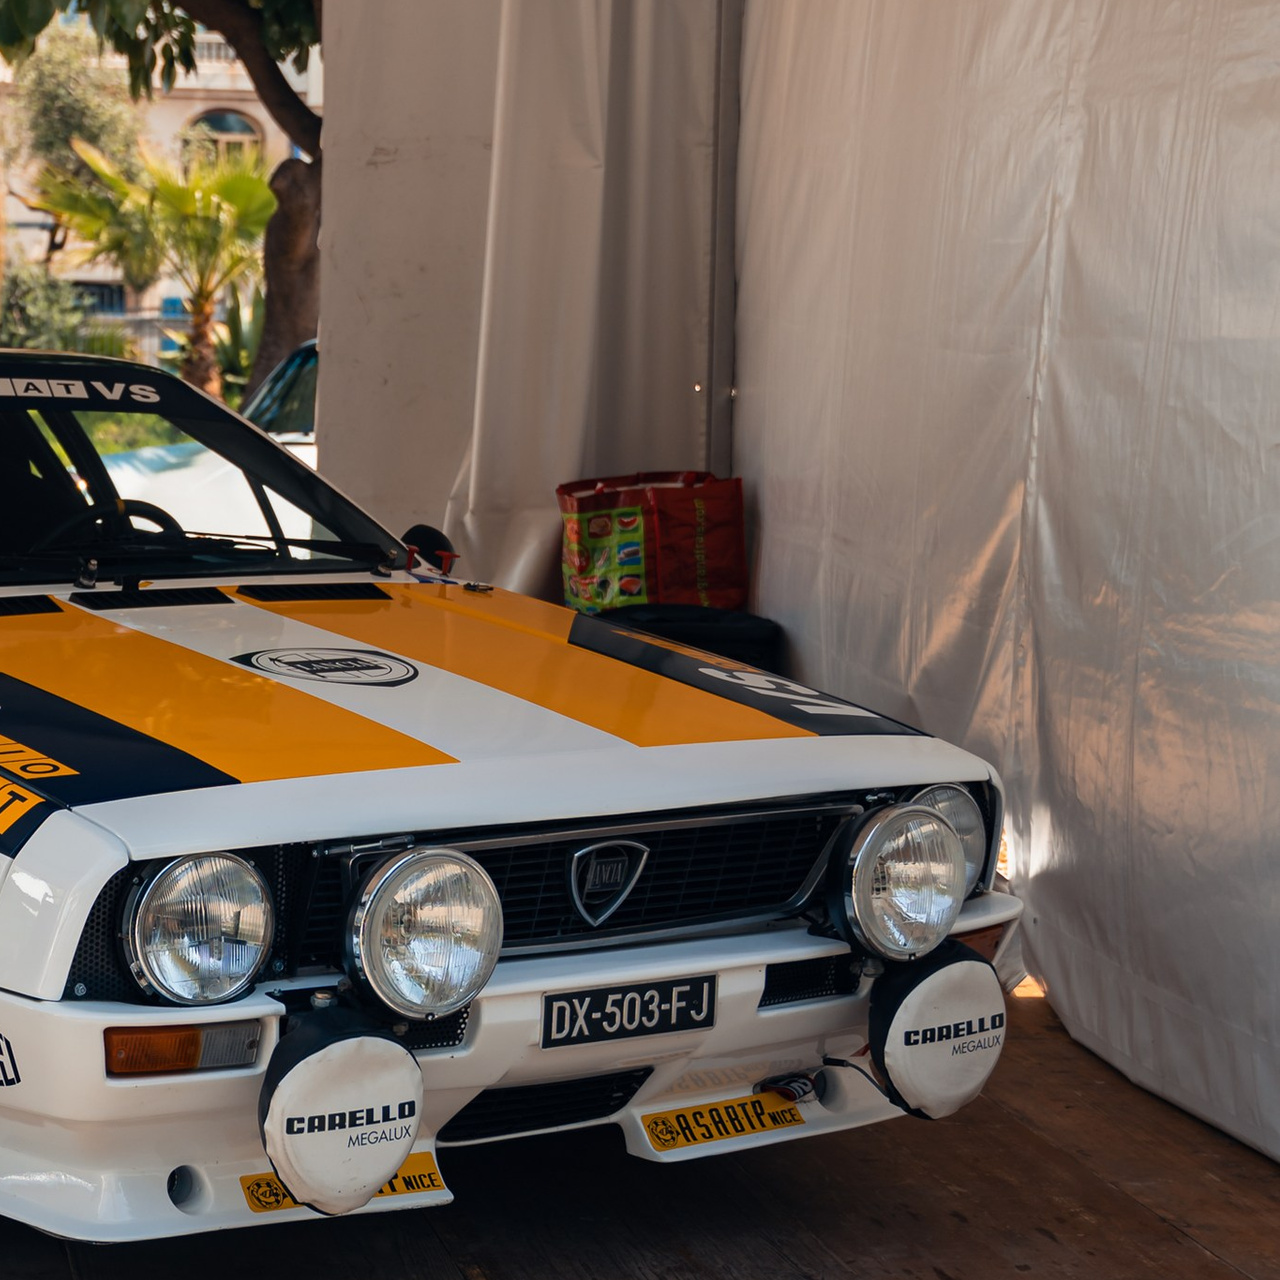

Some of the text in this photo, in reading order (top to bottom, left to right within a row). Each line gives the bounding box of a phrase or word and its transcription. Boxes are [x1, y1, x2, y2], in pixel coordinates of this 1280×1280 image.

[90, 380, 161, 403] VS
[551, 982, 710, 1041] DX-503-FJ
[904, 1013, 1004, 1046] CARELLO
[952, 1034, 1001, 1056] MEGALUX
[285, 1100, 416, 1135] CARELLO
[768, 1108, 801, 1126] NICE
[347, 1124, 411, 1148] MEGALUX
[402, 1172, 441, 1191] NICE
